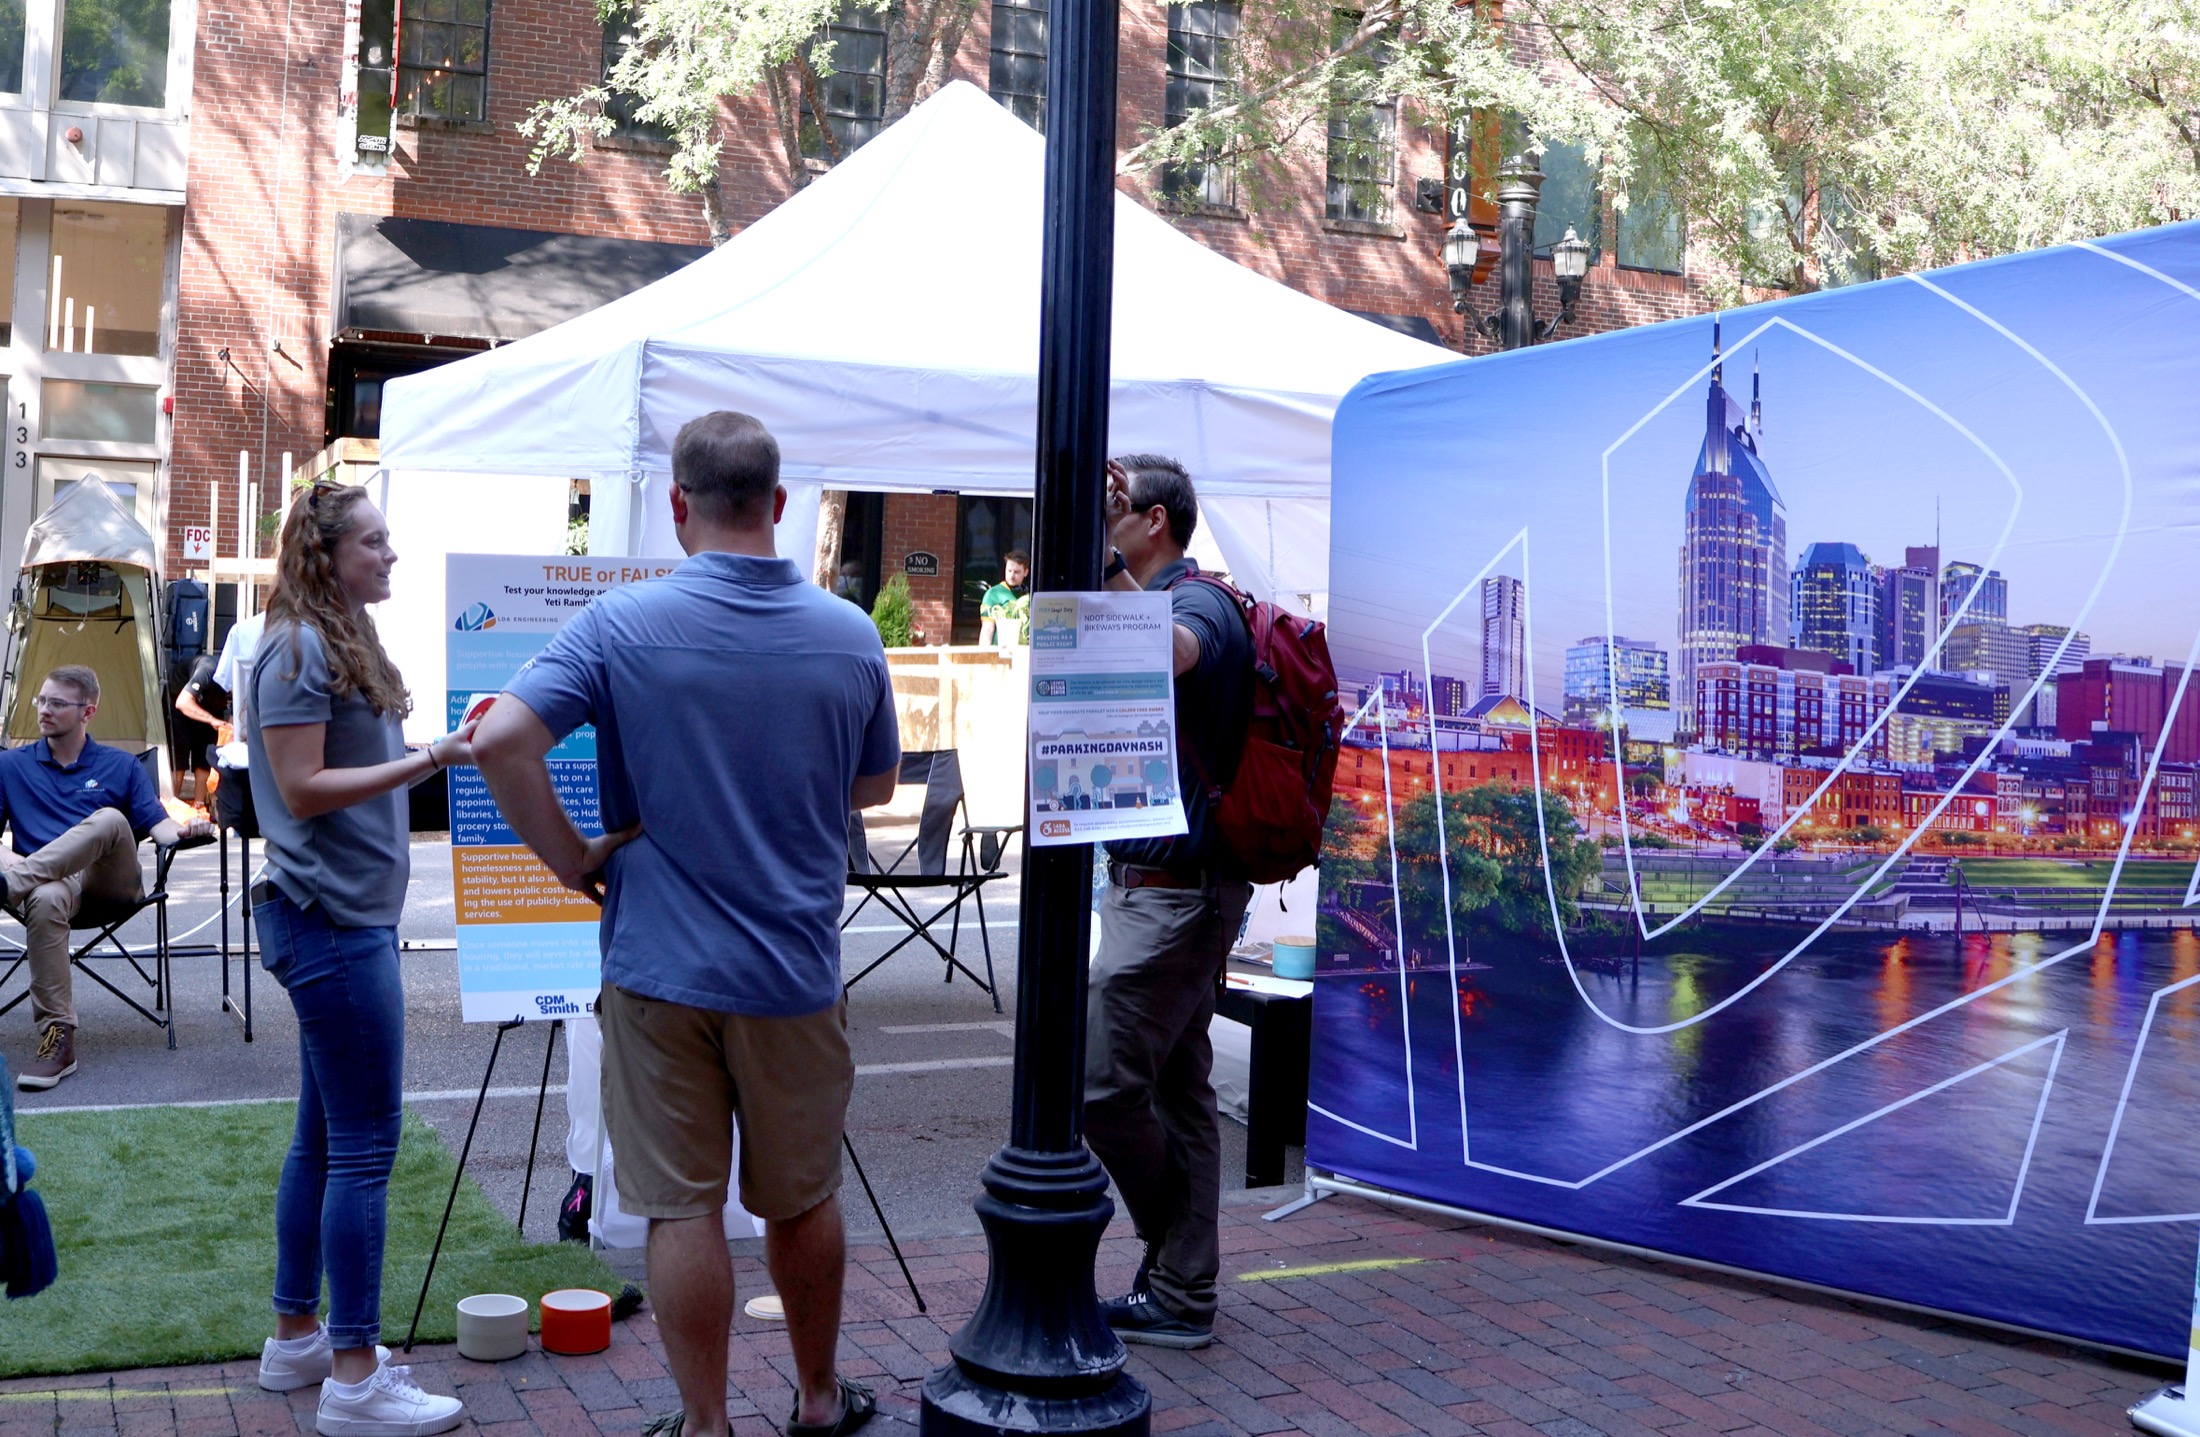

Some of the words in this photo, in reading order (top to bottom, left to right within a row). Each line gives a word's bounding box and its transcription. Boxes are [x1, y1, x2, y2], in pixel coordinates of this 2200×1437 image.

[186, 529, 211, 542] FDC
[915, 557, 928, 565] NO
[543, 566, 592, 582] TRUE
[597, 570, 615, 582] or
[504, 586, 521, 594] Test
[524, 587, 544, 596] your
[547, 587, 594, 597] knowledge
[545, 598, 560, 607] Yeti
[1084, 614, 1104, 622] NDOT
[1084, 624, 1121, 632] BIKEWAYS
[1122, 623, 1161, 631] PROGRAM
[457, 649, 504, 659] Supportive
[457, 662, 487, 671] people
[489, 661, 507, 669] with
[1041, 741, 1163, 755] #PARKINGDAYNASH
[455, 774, 486, 783] housin
[560, 774, 569, 782] to
[456, 785, 486, 796] regular
[456, 810, 494, 819] libraries,
[457, 823, 490, 832] grocery
[457, 834, 486, 845] family.
[461, 853, 509, 862] Supportive
[462, 864, 522, 872] homelessness
[525, 863, 540, 871] and
[463, 876, 499, 885] stability,
[528, 874, 545, 882] also
[463, 887, 480, 895] and
[483, 887, 511, 895] lowers
[513, 886, 540, 896] public
[464, 899, 478, 908] ing
[515, 897, 525, 905] of
[535, 995, 565, 1006] CDM
[540, 1002, 579, 1014] Smith
